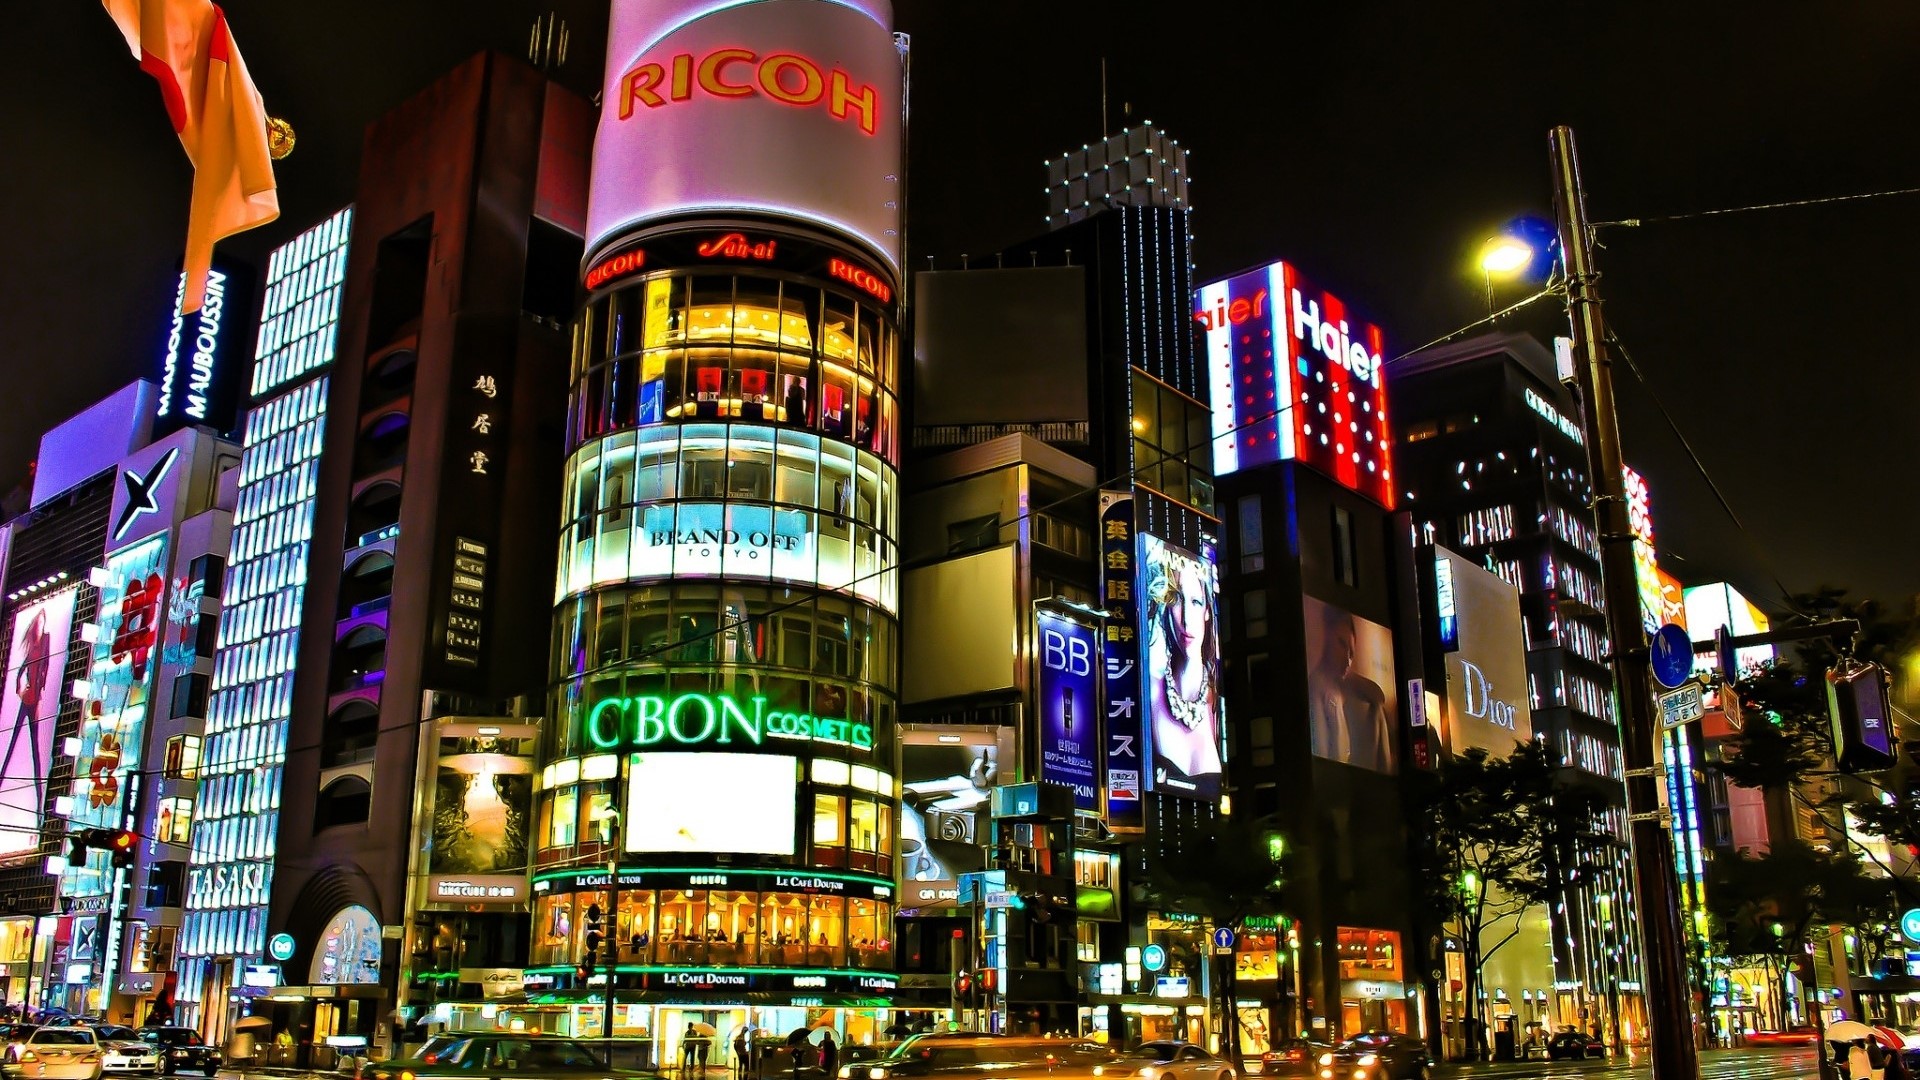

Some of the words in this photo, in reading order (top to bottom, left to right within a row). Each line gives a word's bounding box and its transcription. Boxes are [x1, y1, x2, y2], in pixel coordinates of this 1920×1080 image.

[618, 48, 877, 136] RICOH
[585, 249, 645, 290] RICOH
[828, 258, 890, 302] RICOH
[1194, 288, 1267, 331] aier
[185, 269, 226, 418] MAUBOUSSIN
[1291, 287, 1382, 389] Haier
[650, 529, 740, 547] BRAND
[749, 530, 801, 551] OFF
[688, 548, 759, 560] TOYO
[1106, 519, 1130, 601] 英会話
[1045, 629, 1090, 678] B.B
[1107, 657, 1136, 758] ジオス
[1461, 659, 1519, 731] Dior
[589, 693, 767, 748] C'BON
[766, 711, 872, 748] COSMETCS
[190, 863, 264, 894] TASAKI
[938, 889, 958, 900] DIG
[664, 973, 677, 984] LE
[679, 973, 704, 984] CAFÉ
[706, 973, 745, 984] DOUTOR
